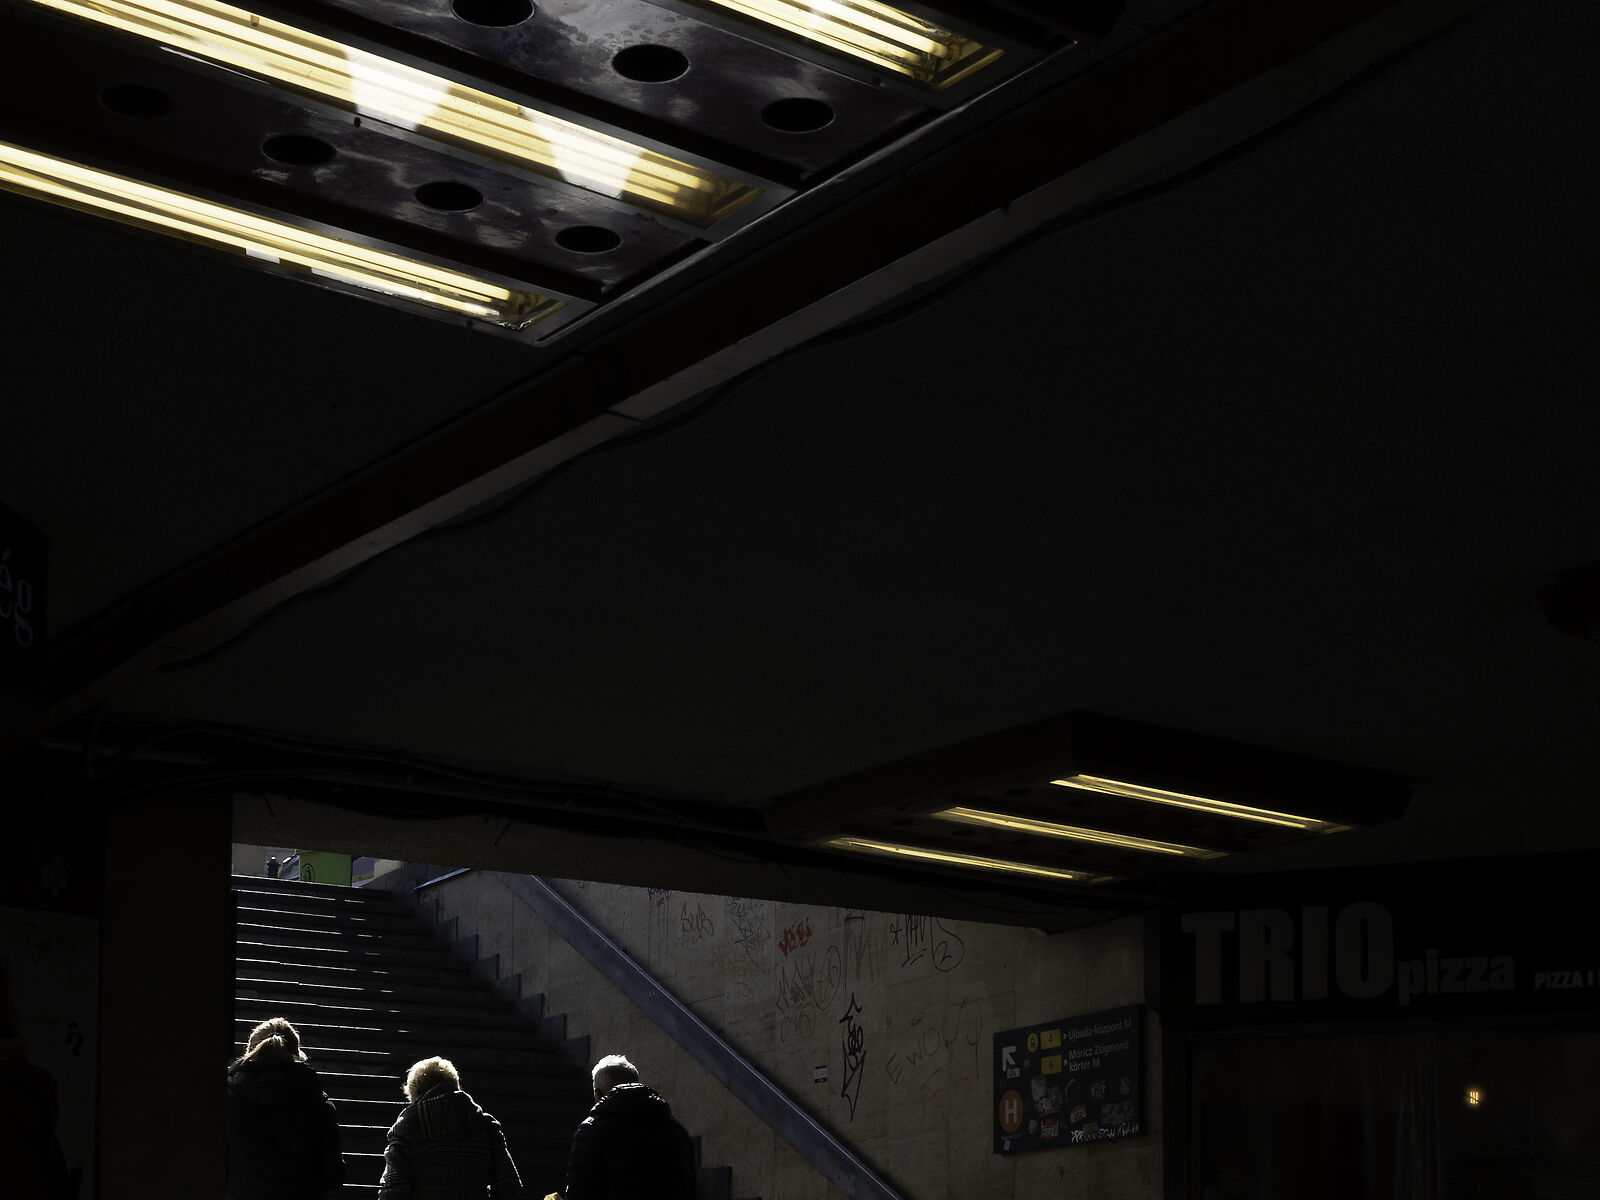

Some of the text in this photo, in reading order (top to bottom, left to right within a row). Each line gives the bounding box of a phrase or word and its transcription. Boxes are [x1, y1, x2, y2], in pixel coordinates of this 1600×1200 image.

[1181, 900, 1394, 1006] TRIO
[1398, 949, 1516, 1007] pizza
[1534, 970, 1584, 990] PIZZA
[1092, 1057, 1100, 1068] M
[1005, 1098, 1018, 1125] H
